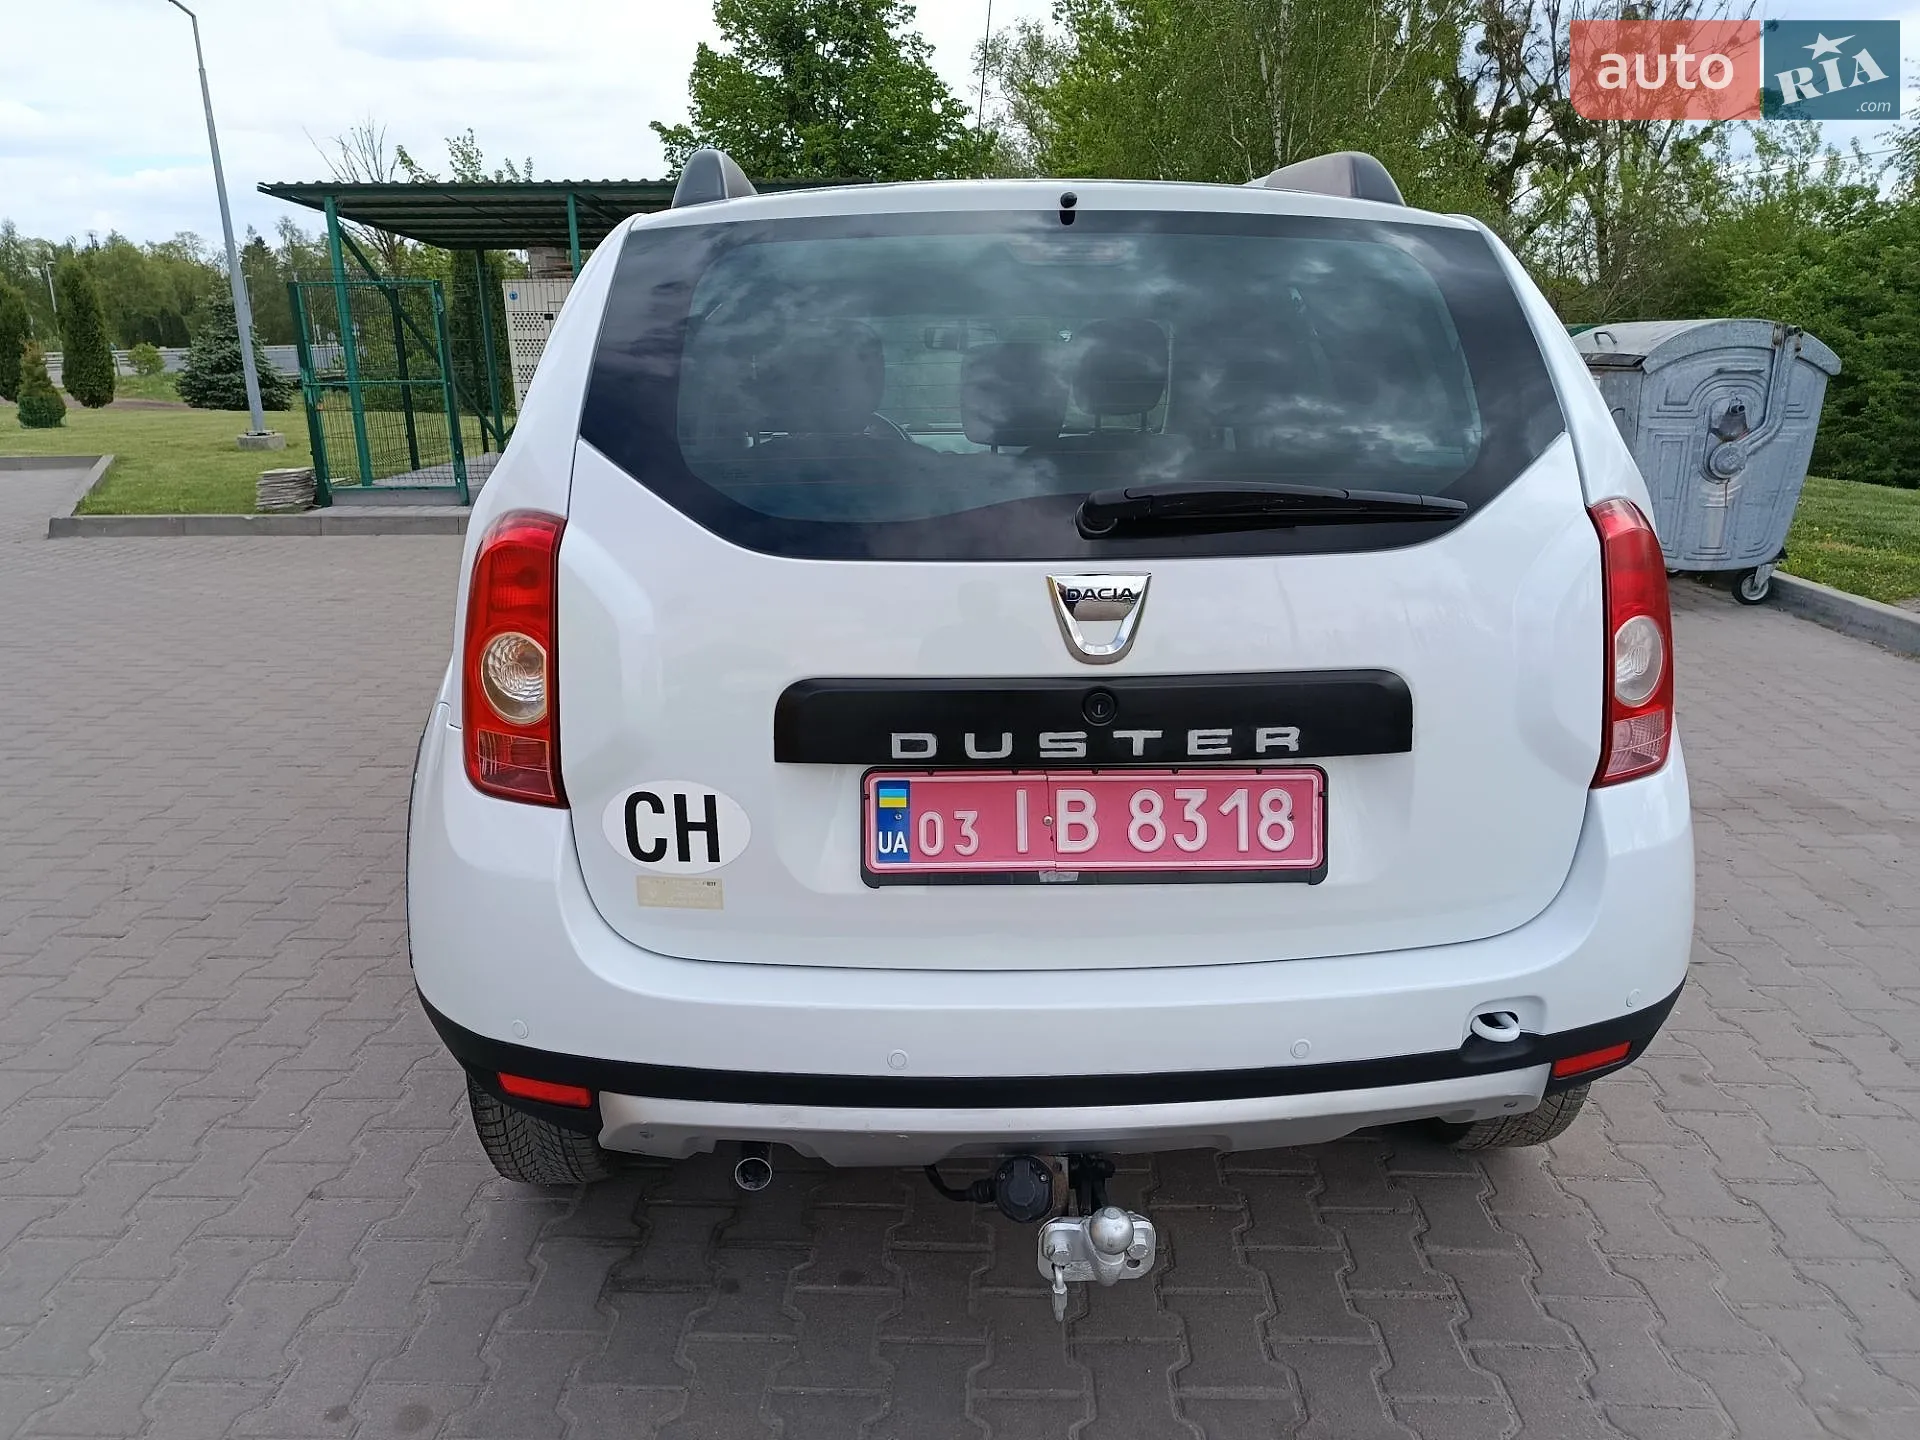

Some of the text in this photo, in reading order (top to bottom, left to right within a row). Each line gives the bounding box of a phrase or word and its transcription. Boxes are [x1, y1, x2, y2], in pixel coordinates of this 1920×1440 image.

[1066, 588, 1135, 601] DACIA
[891, 726, 1299, 760] DUSTER
[624, 791, 721, 863] CH
[918, 810, 980, 856] 03
[1127, 788, 1295, 853] 8318
[878, 830, 908, 854] UA
